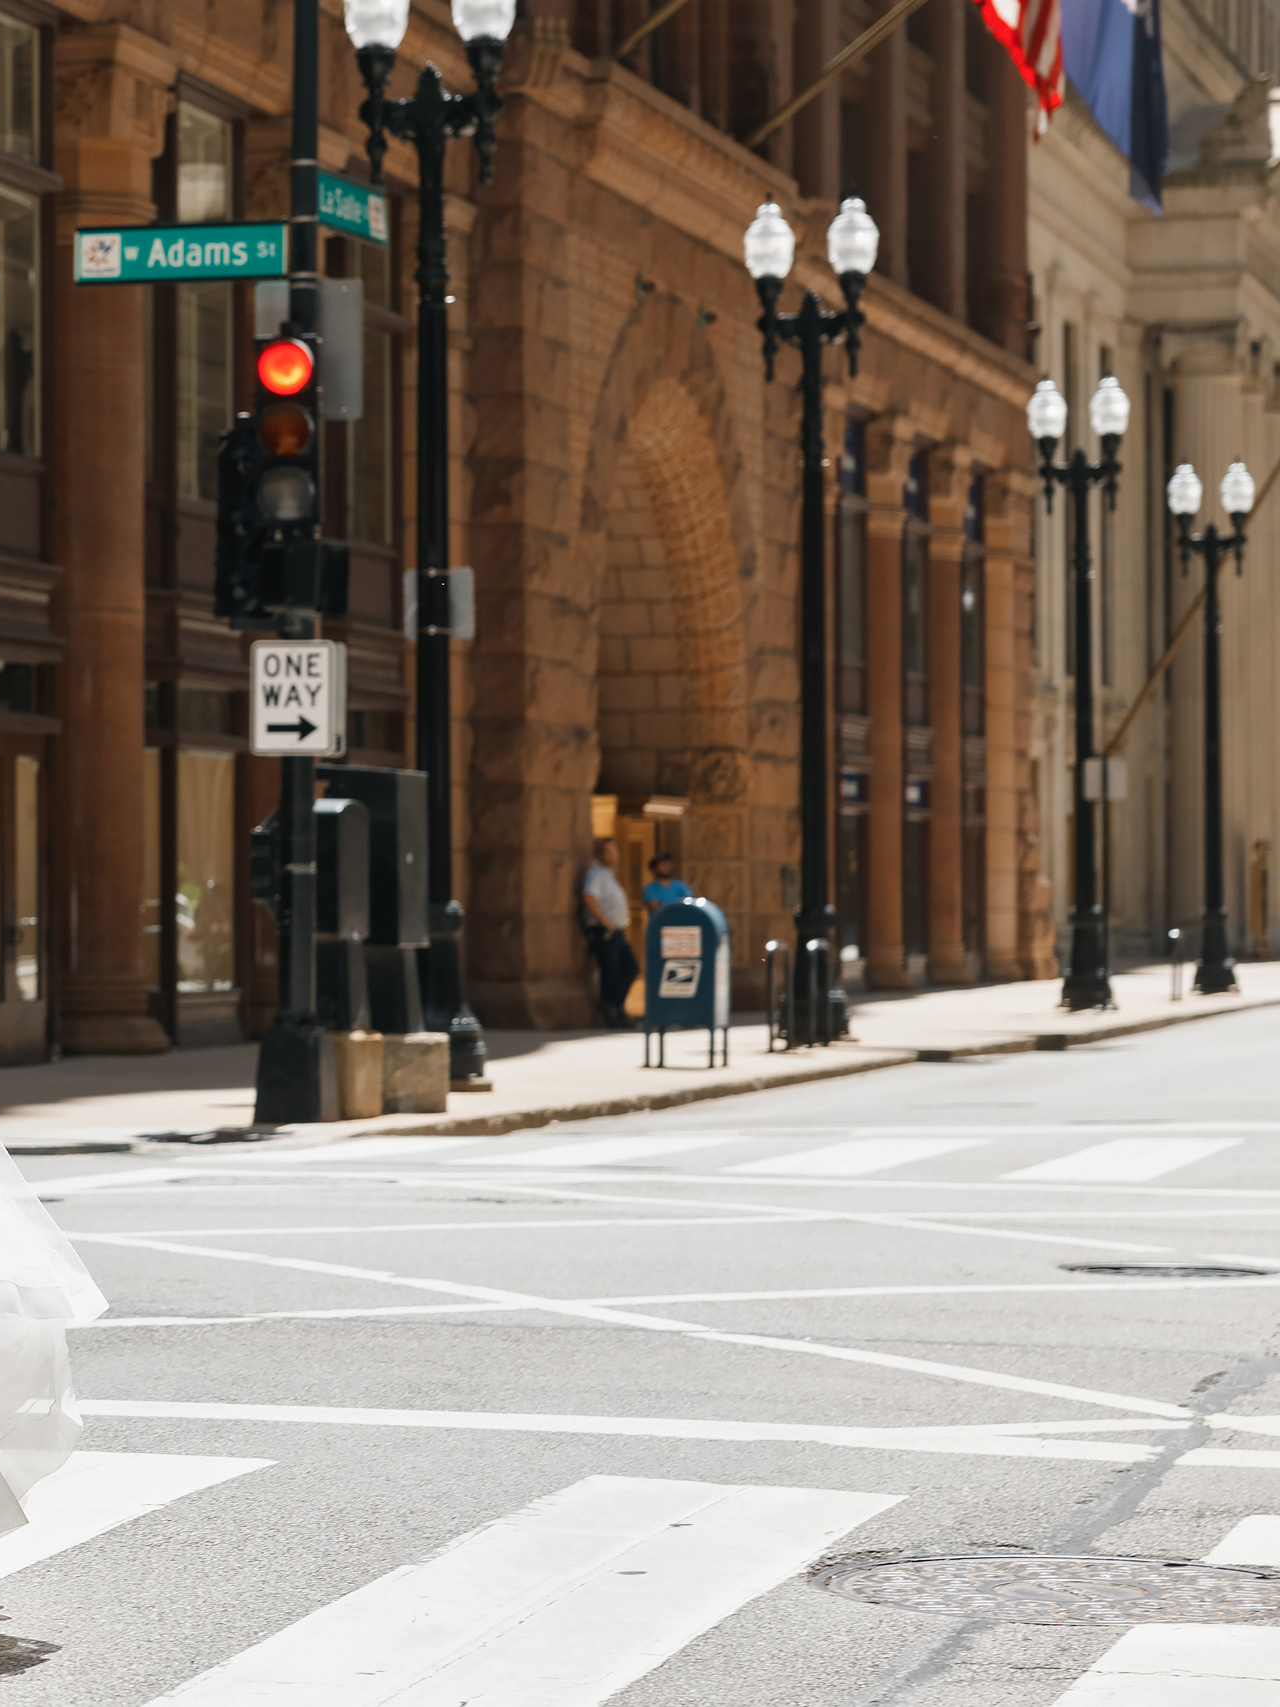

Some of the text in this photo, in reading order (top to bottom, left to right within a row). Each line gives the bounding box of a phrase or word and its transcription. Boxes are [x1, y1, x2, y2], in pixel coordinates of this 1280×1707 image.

[123, 238, 276, 268] W Adams St
[263, 653, 321, 677] ONE
[262, 684, 322, 707] WAY
